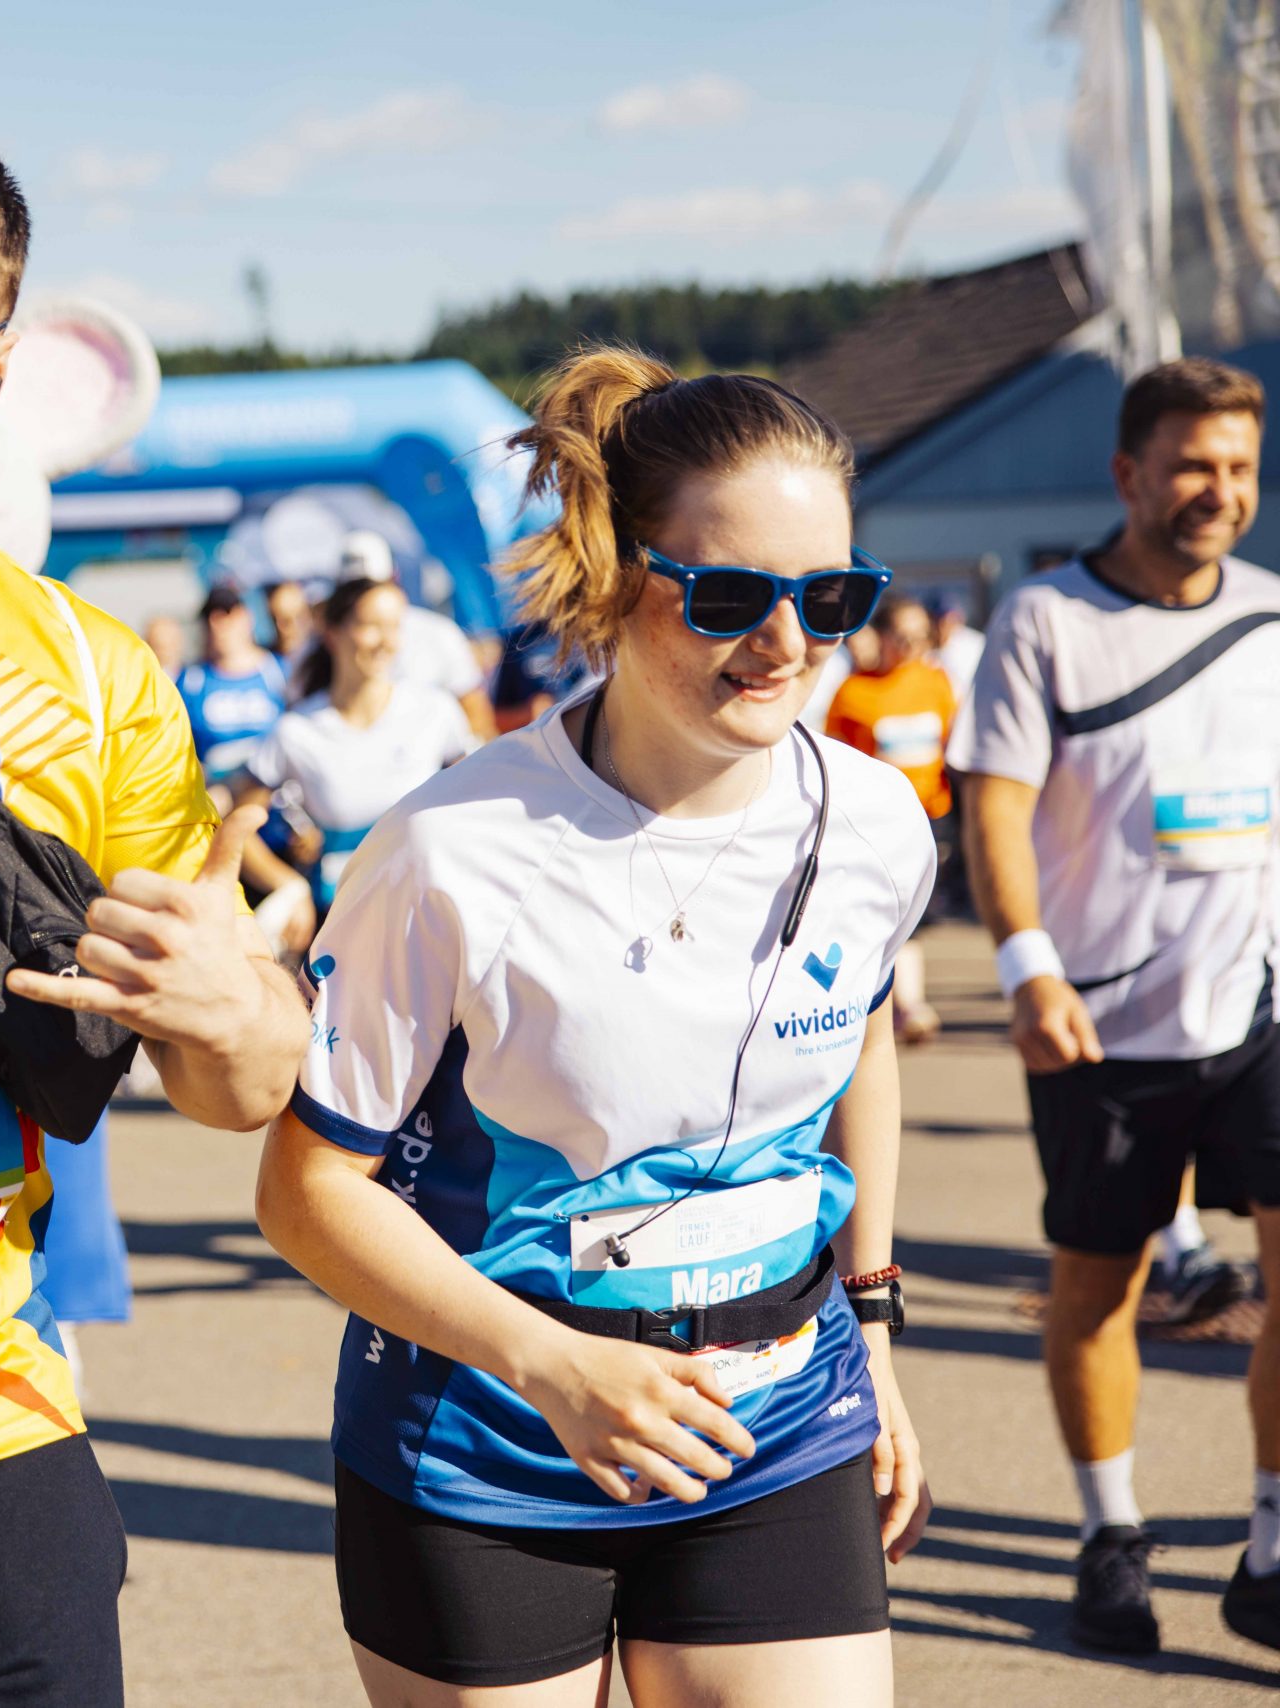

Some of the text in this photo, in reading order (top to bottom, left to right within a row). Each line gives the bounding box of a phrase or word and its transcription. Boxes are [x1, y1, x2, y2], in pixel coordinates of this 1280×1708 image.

[679, 1232, 711, 1248] LAUF
[671, 1262, 763, 1309] Mara
[755, 1341, 770, 1353] dm
